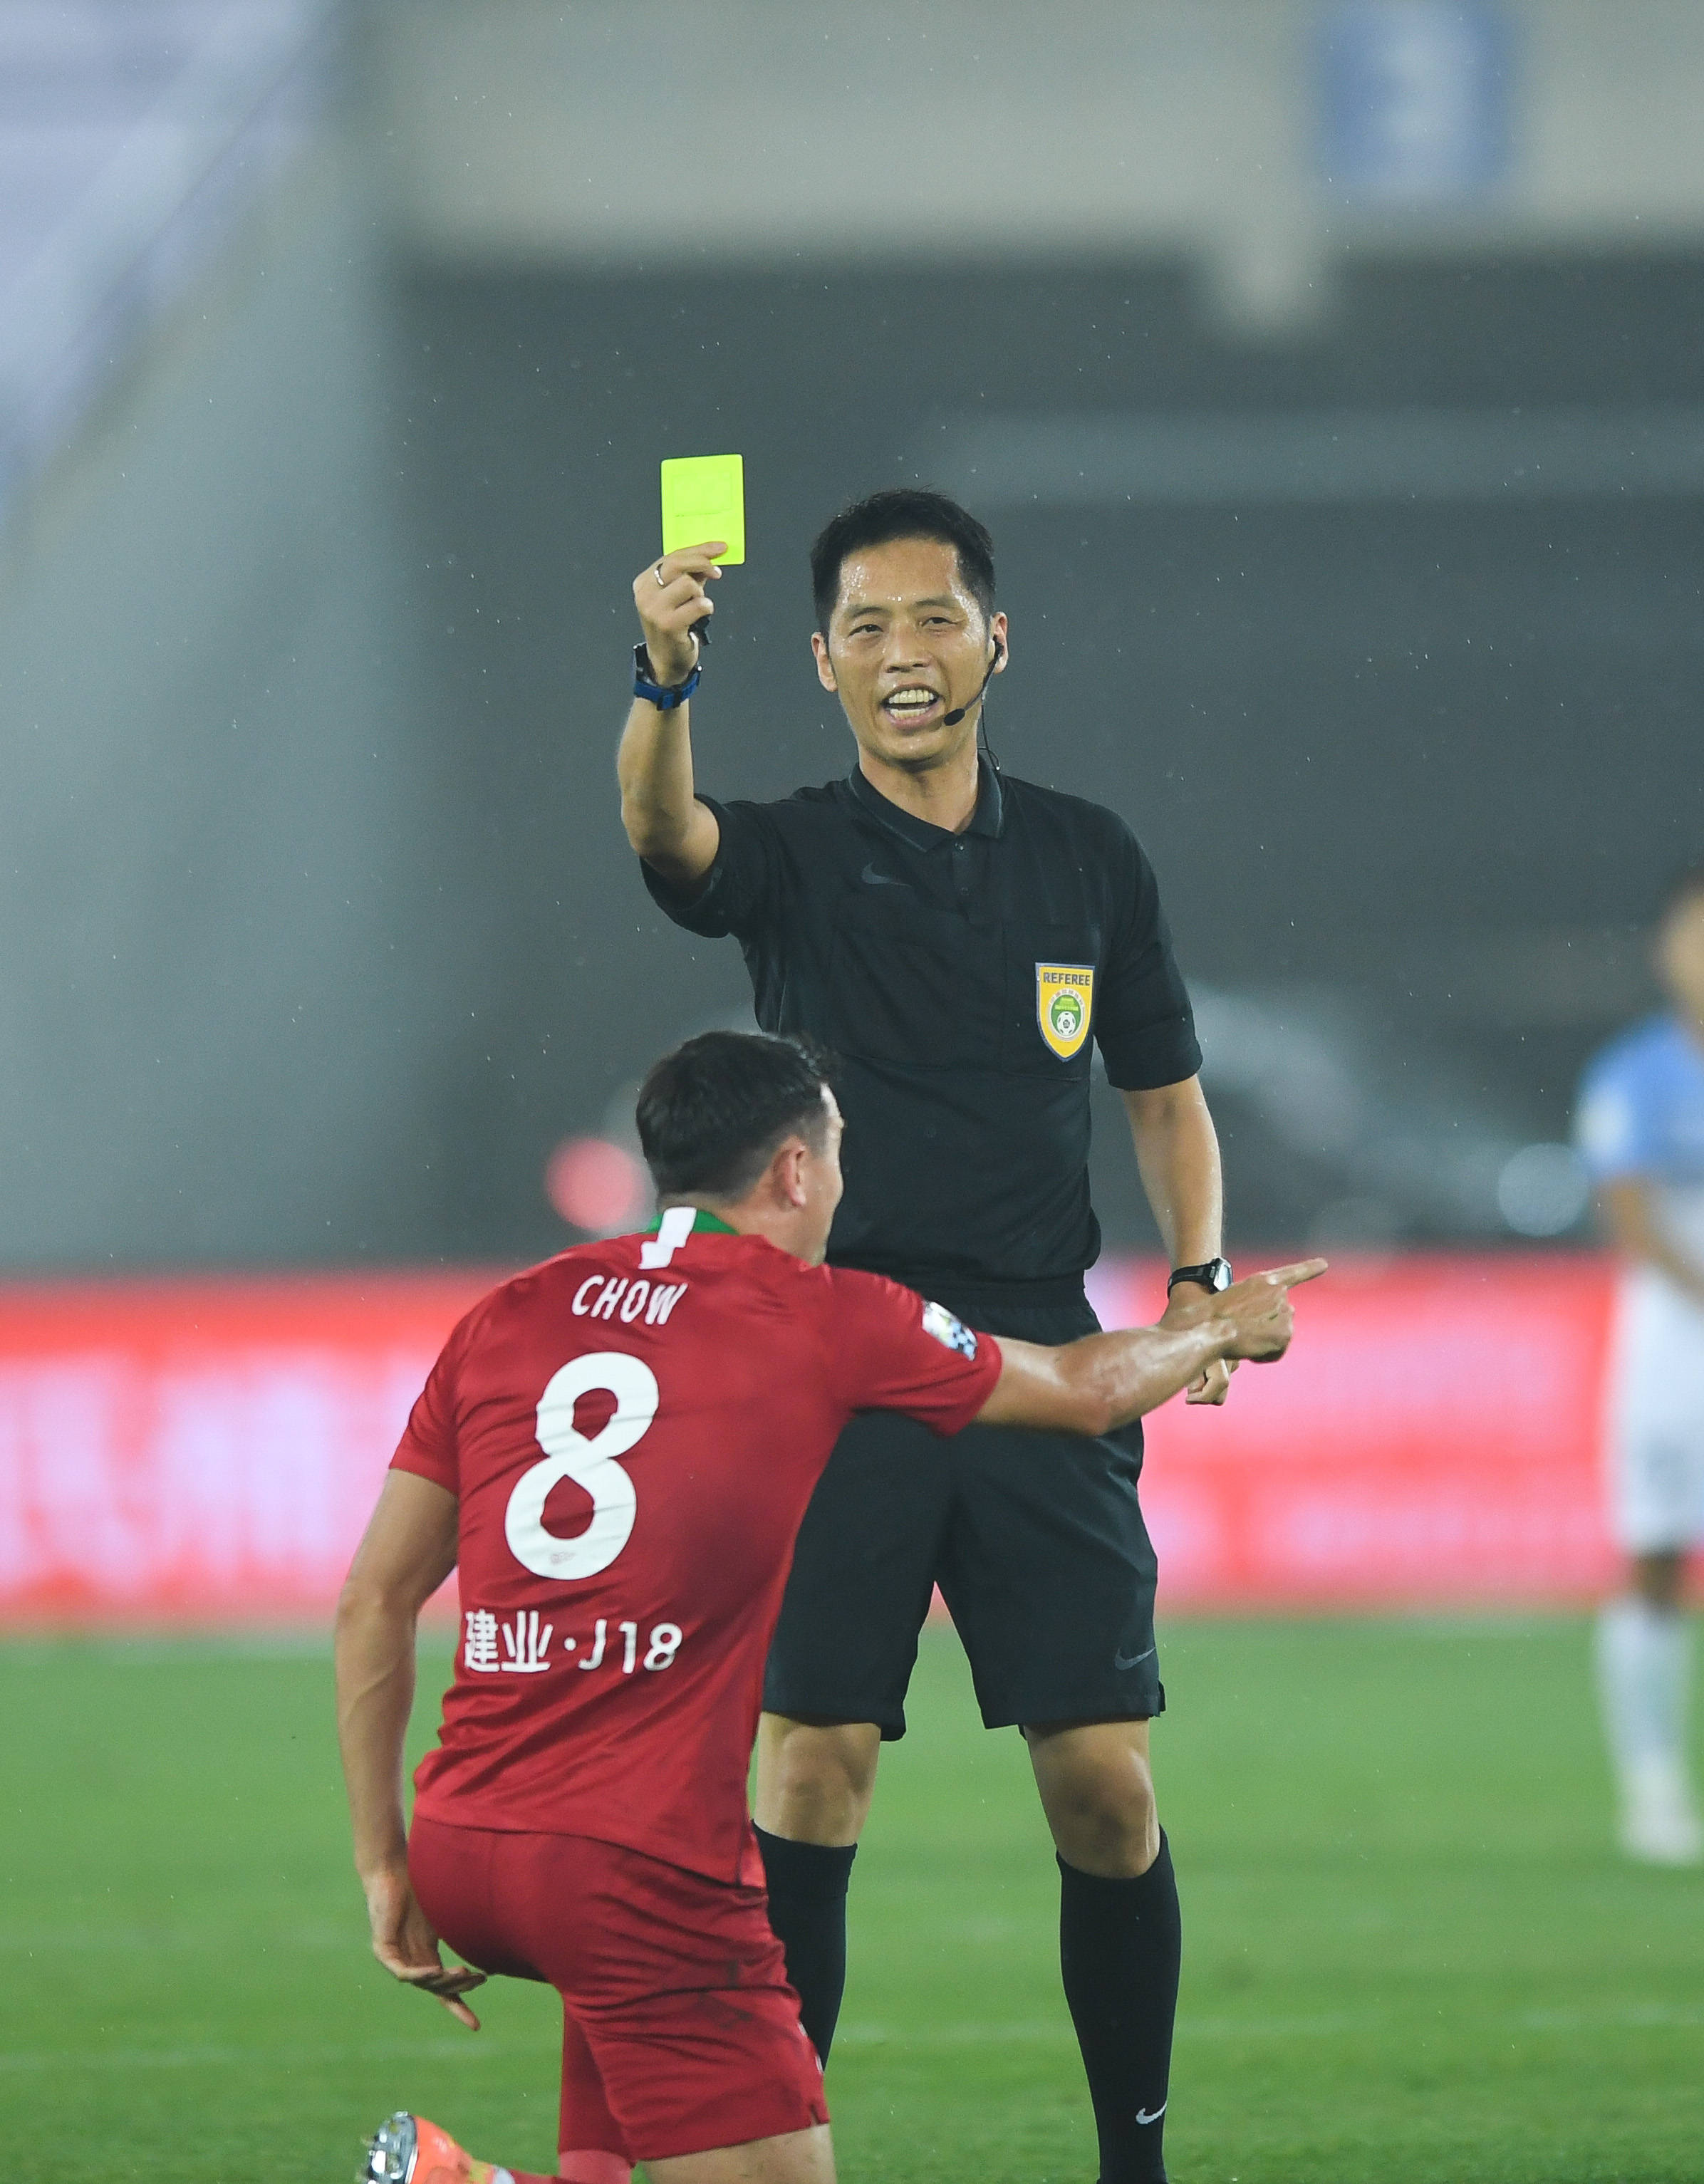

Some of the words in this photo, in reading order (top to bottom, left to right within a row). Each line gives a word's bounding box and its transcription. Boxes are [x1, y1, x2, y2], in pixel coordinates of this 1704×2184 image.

[1043, 972, 1091, 986] REFEREE
[572, 1274, 687, 1325] CHOW
[504, 1351, 659, 1581] 8
